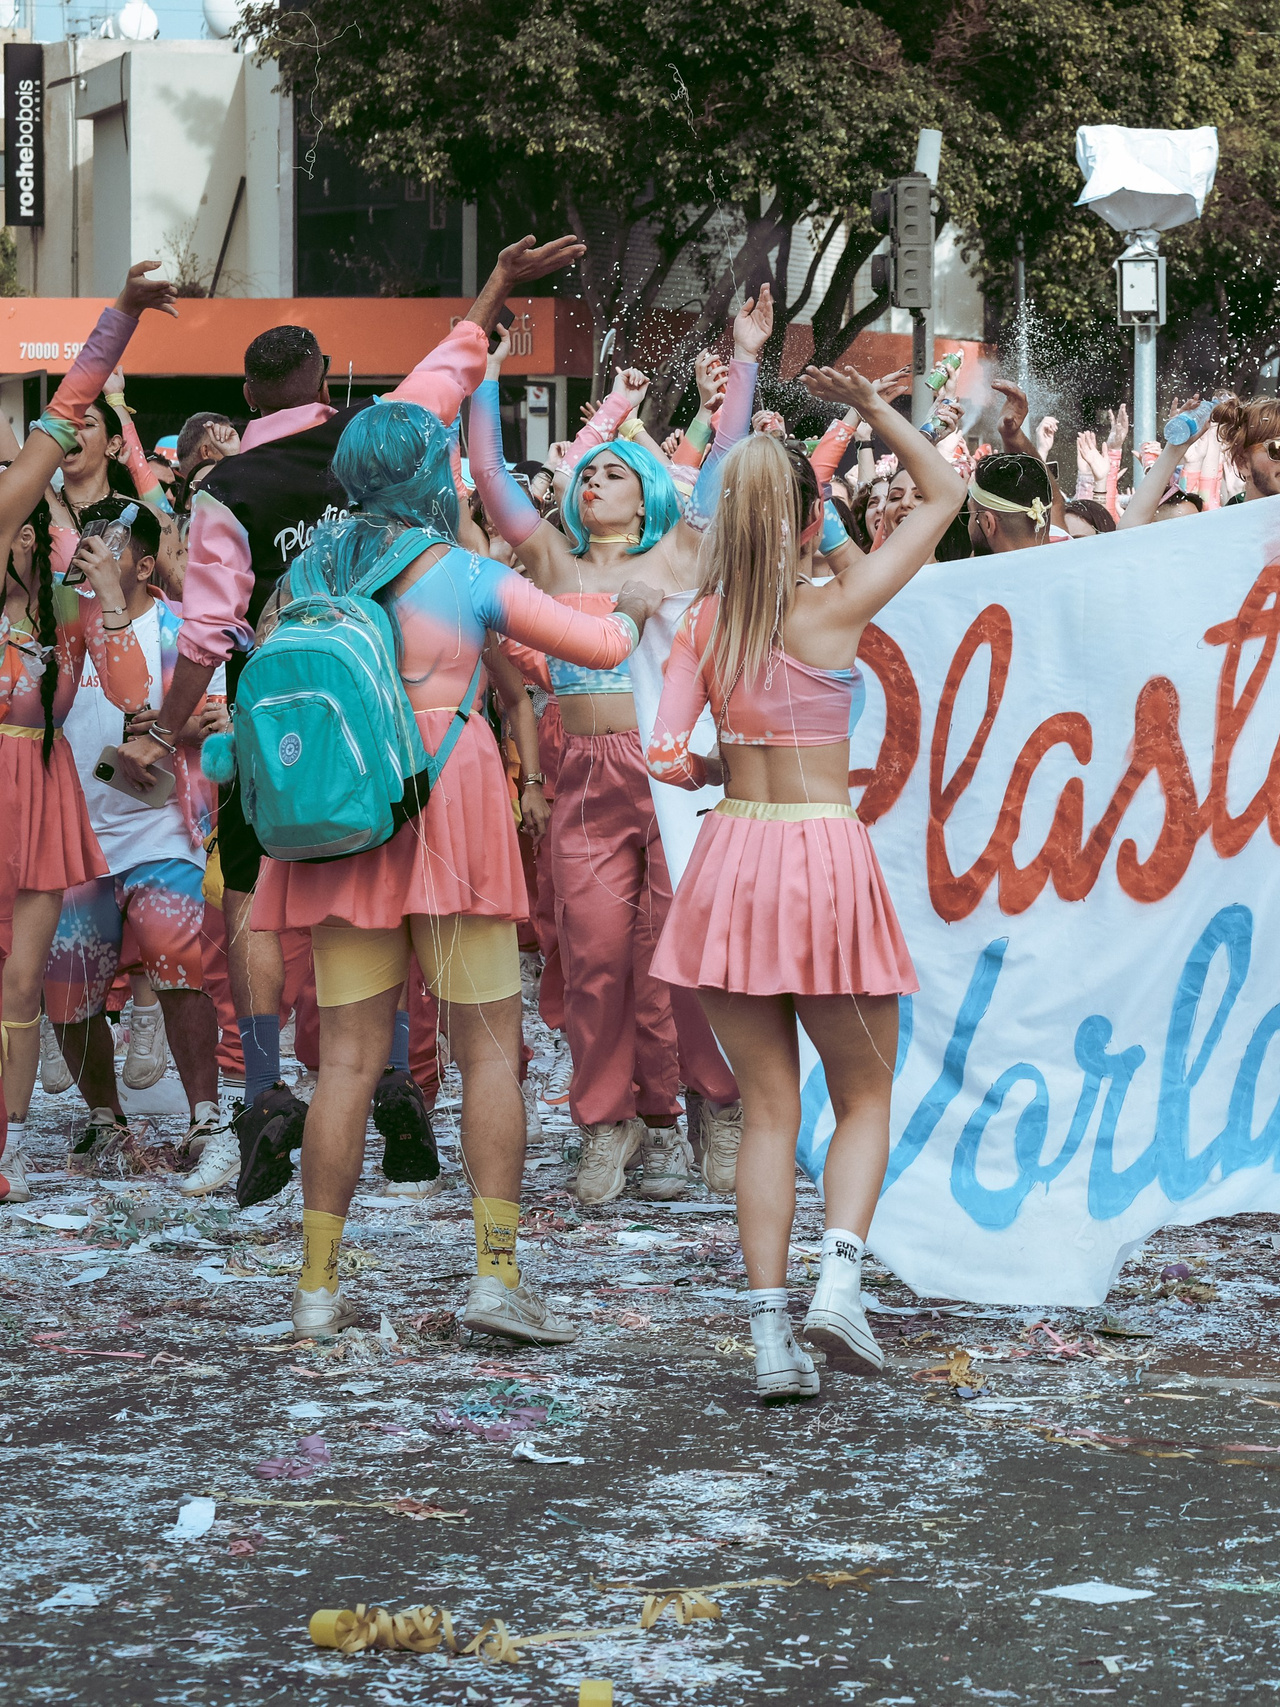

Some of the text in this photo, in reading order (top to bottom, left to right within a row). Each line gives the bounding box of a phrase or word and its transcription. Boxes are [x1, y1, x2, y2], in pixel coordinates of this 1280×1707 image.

[15, 79, 34, 217] rochebobois
[20, 342, 86, 360] 70000 59
